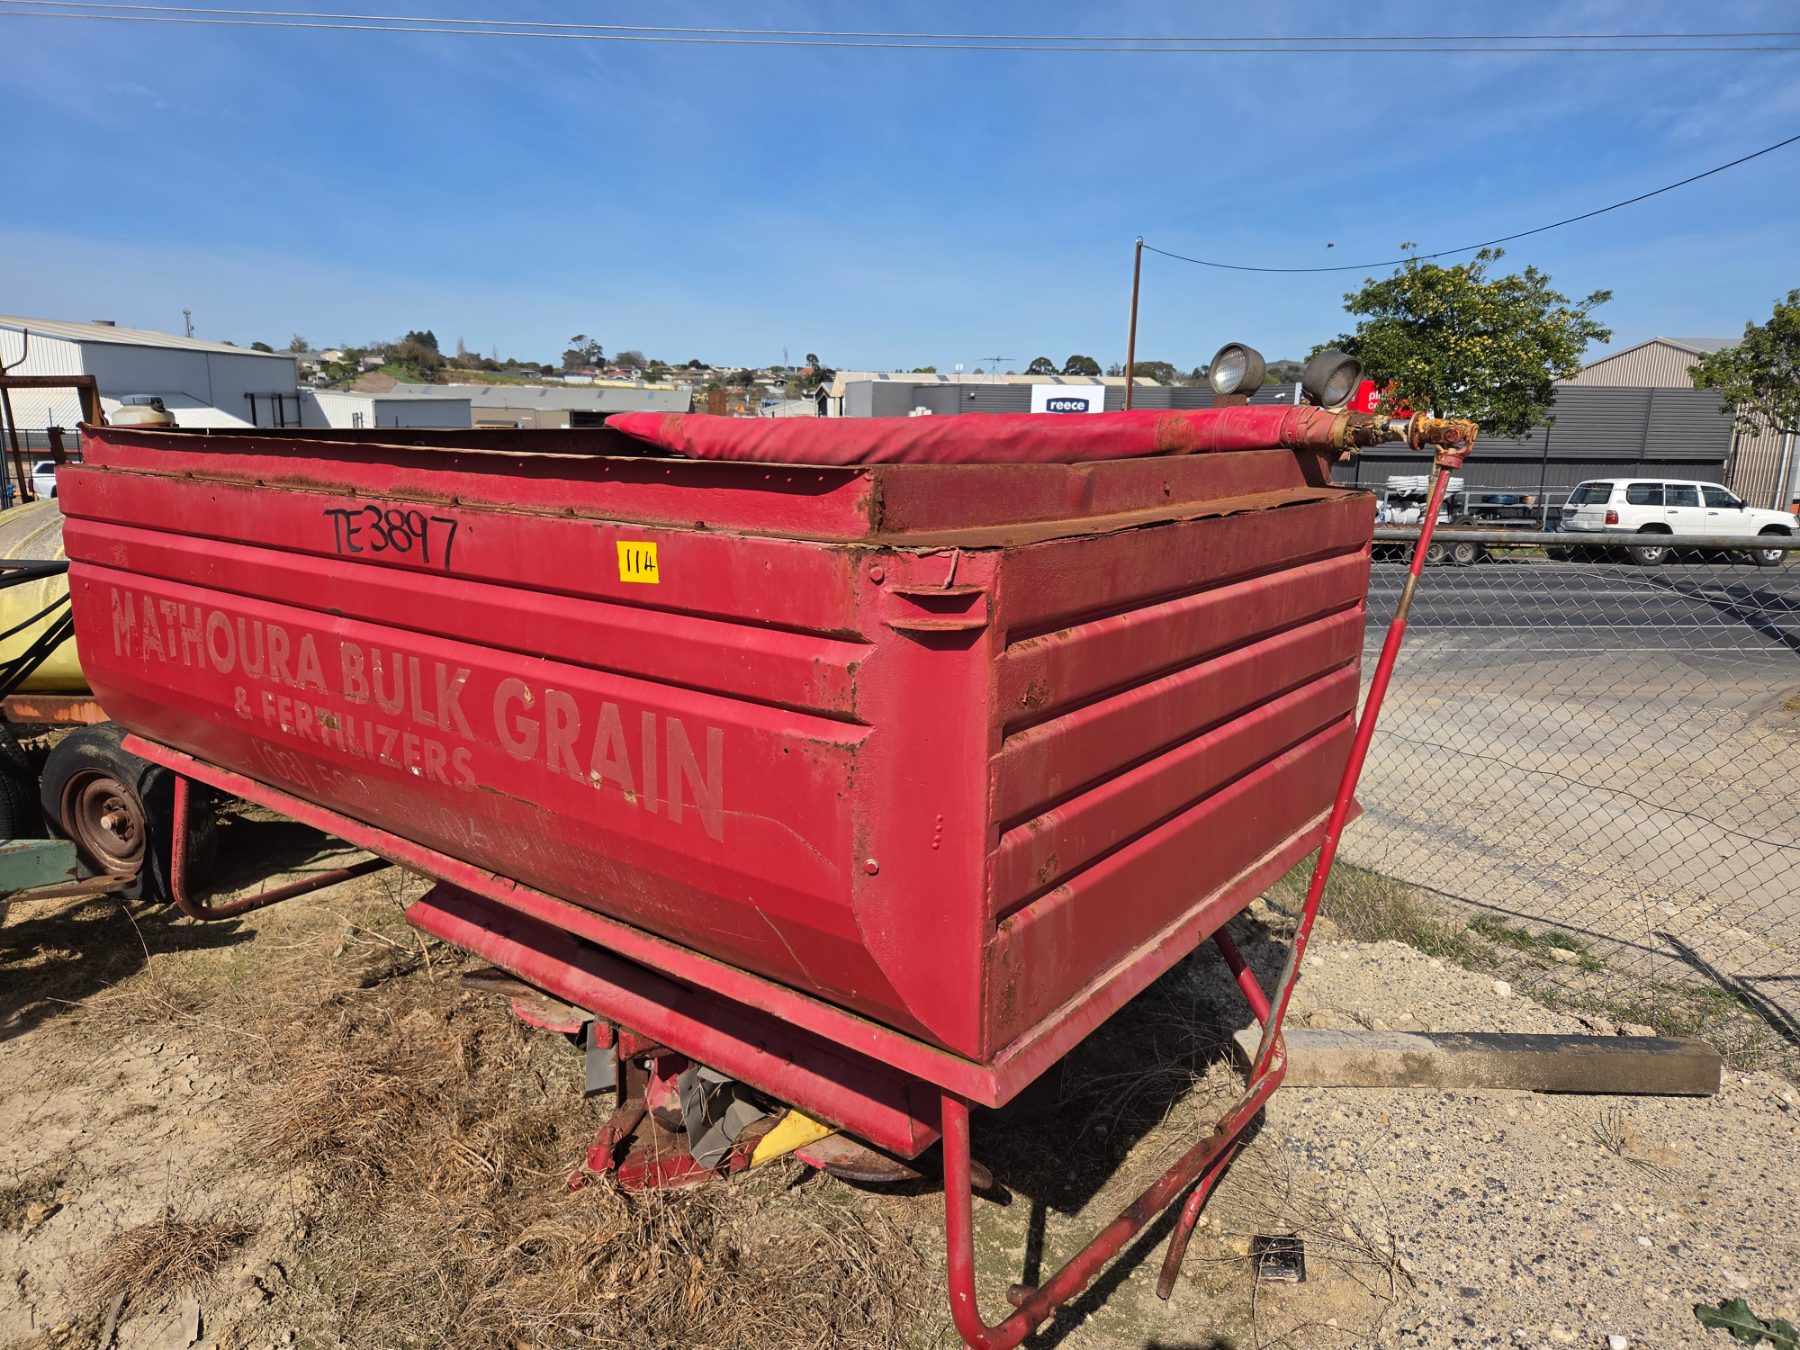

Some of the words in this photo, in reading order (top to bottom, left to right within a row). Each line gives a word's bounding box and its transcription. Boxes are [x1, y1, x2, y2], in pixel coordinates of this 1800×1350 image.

[1050, 401, 1086, 411] reece
[323, 504, 458, 571] TE3897
[626, 549, 656, 574] 114
[110, 587, 328, 696] MATHOURA
[340, 641, 476, 742] BULK
[493, 677, 724, 843] GRAIN
[234, 686, 253, 721] &
[261, 691, 476, 792] FERTILIZERS
